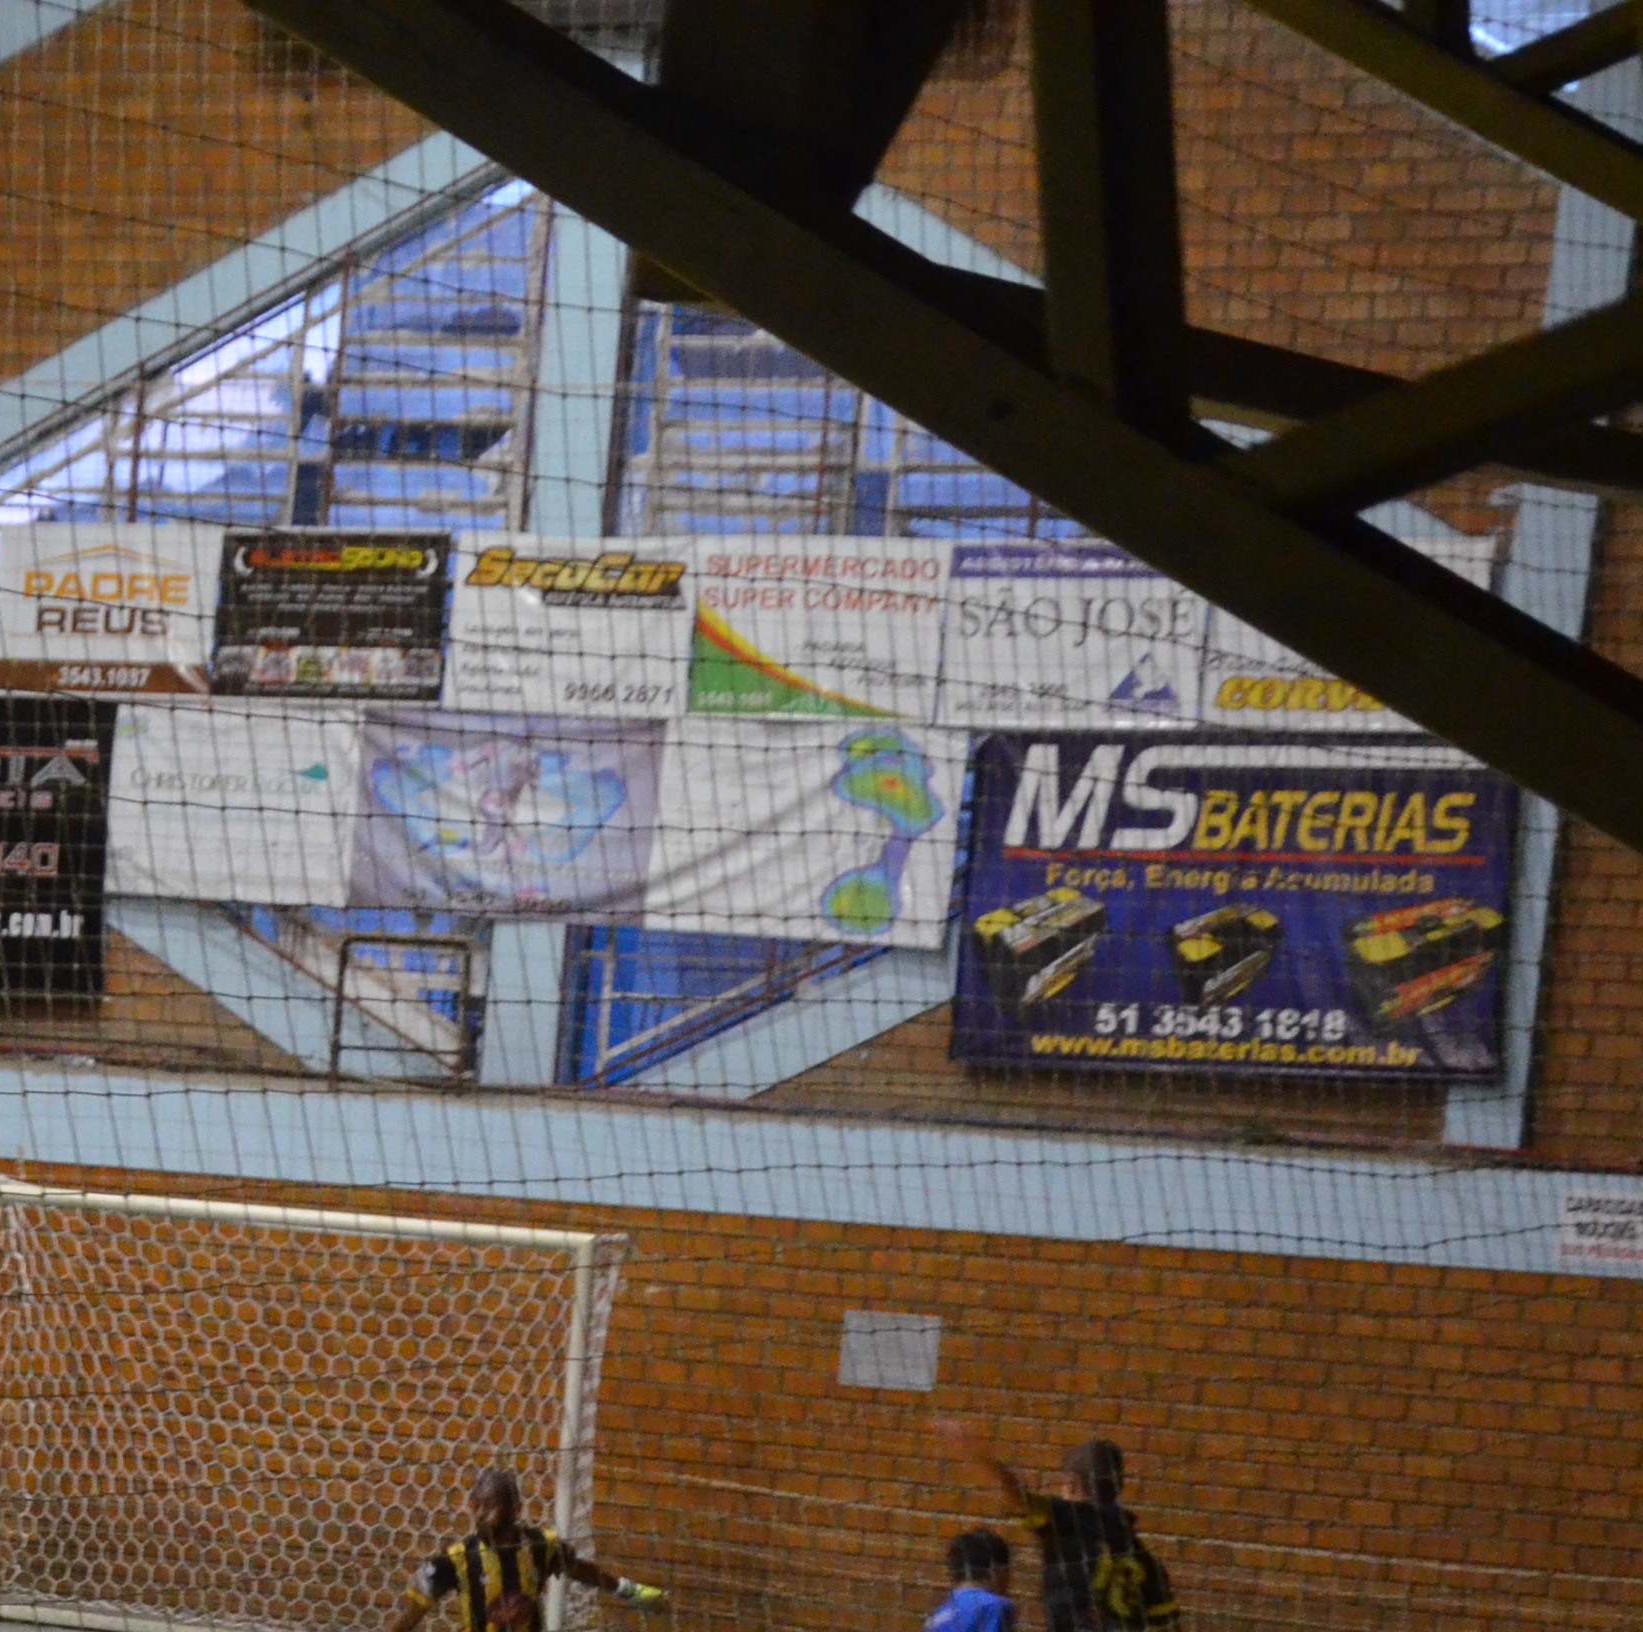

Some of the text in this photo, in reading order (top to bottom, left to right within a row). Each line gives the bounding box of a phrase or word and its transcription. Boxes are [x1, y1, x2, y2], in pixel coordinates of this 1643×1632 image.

[706, 553, 941, 580] SUPERMERCADO
[24, 569, 191, 605] PADRE
[703, 585, 938, 613] SUPER COMPANY
[35, 605, 172, 636] REUS
[1190, 789, 1478, 855] BATERIAS
[1094, 1002, 1141, 1036] 51
